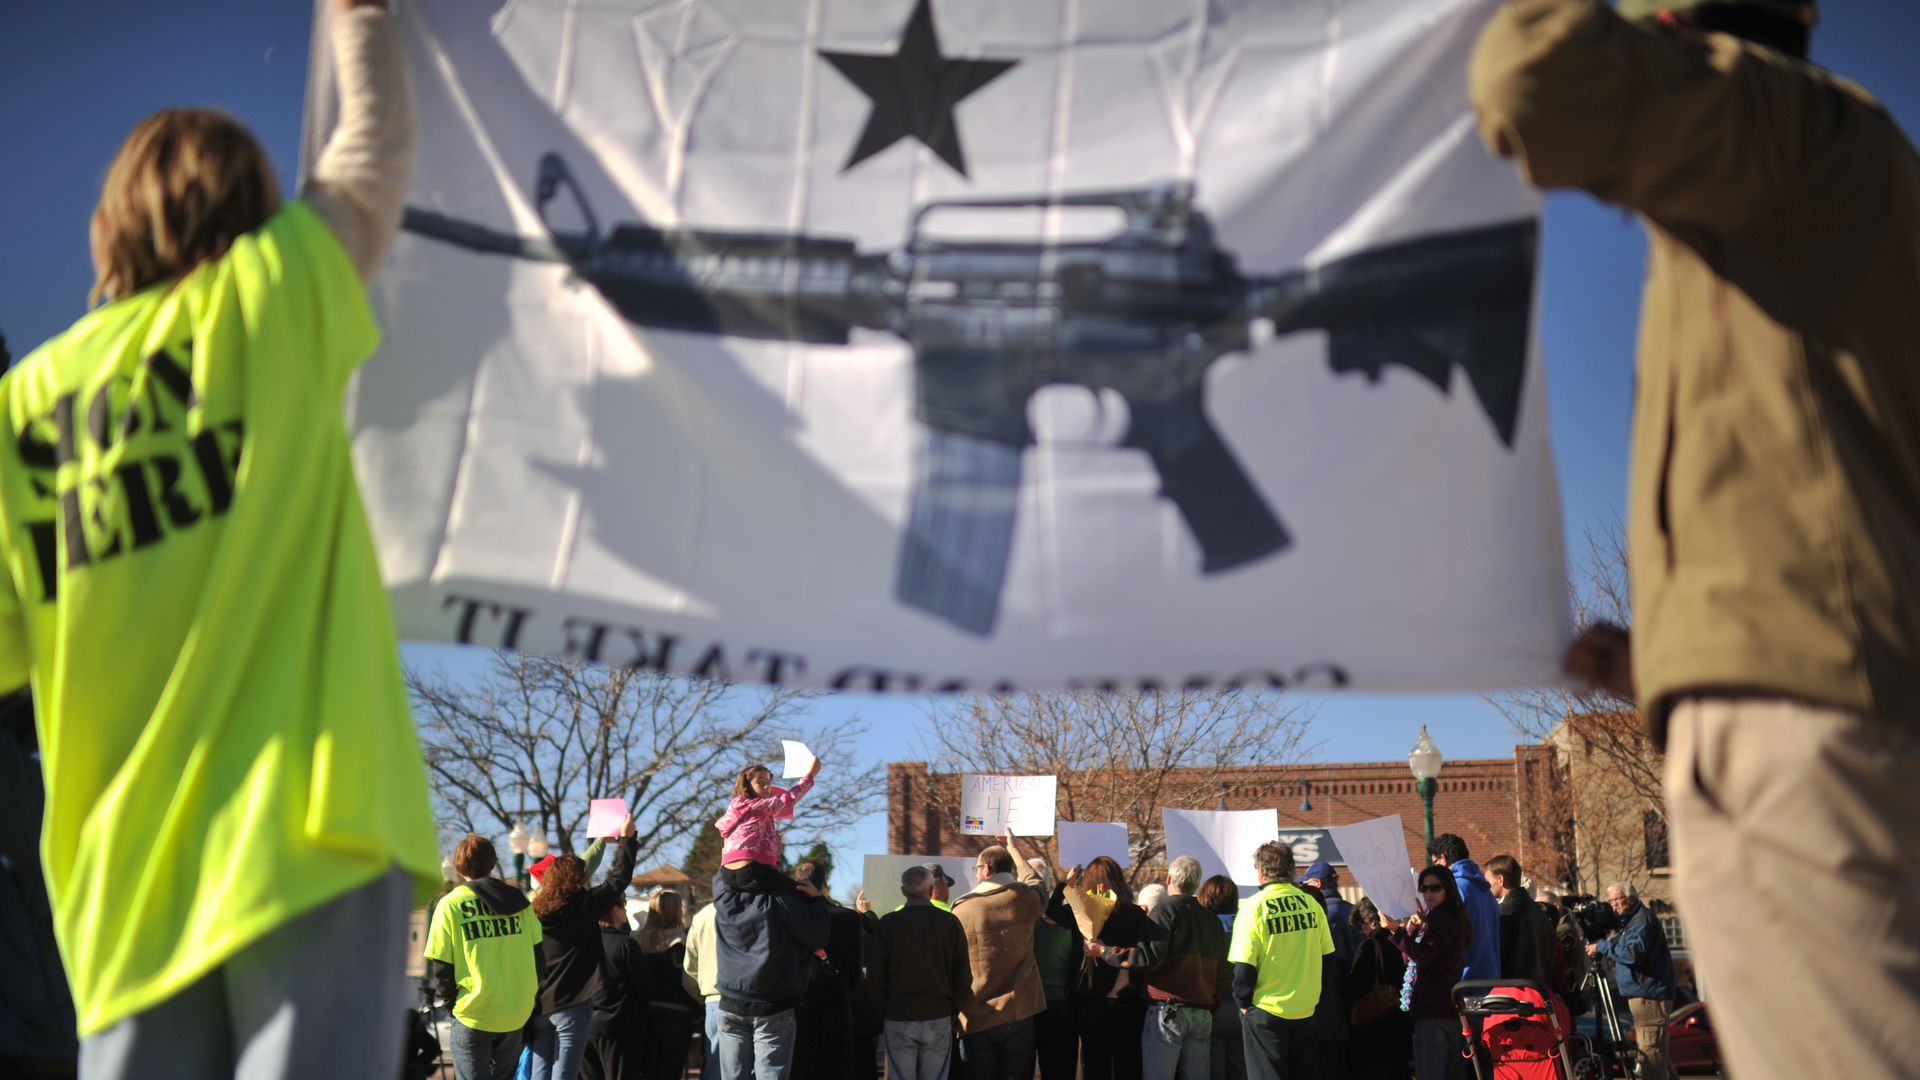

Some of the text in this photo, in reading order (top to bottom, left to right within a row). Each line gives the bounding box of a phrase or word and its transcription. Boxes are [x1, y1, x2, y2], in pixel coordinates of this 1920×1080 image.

[460, 898, 497, 919] SI
[1265, 894, 1309, 915] SIGN
[460, 916, 522, 941] HERE
[1267, 911, 1318, 935] HERE
